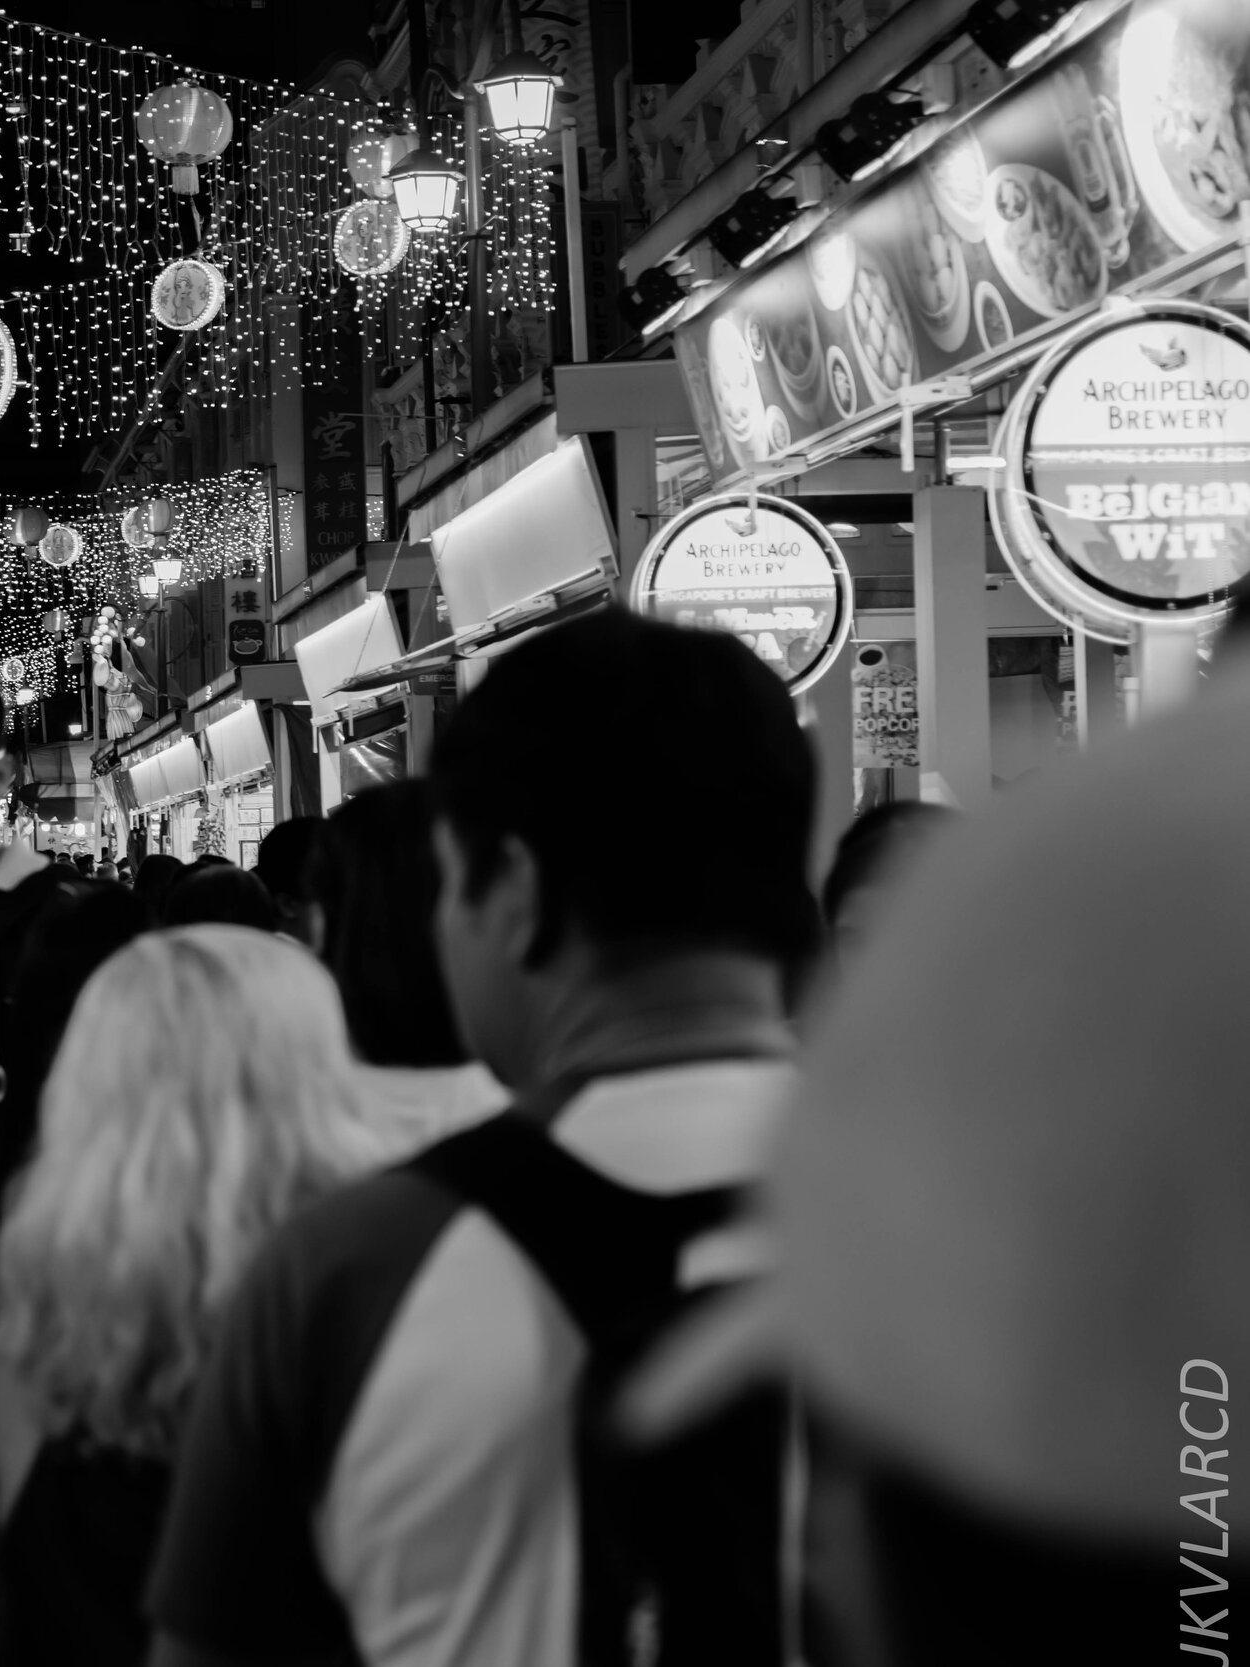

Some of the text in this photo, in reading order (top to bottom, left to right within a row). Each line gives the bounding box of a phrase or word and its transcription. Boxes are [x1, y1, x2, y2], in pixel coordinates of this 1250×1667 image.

[1082, 378, 1250, 402] ARCHIPELAGO
[1109, 405, 1227, 430] BREWERY
[317, 531, 355, 546] CHOP
[685, 541, 801, 559] ARCHIPELAGO
[703, 560, 786, 578] BREWERY
